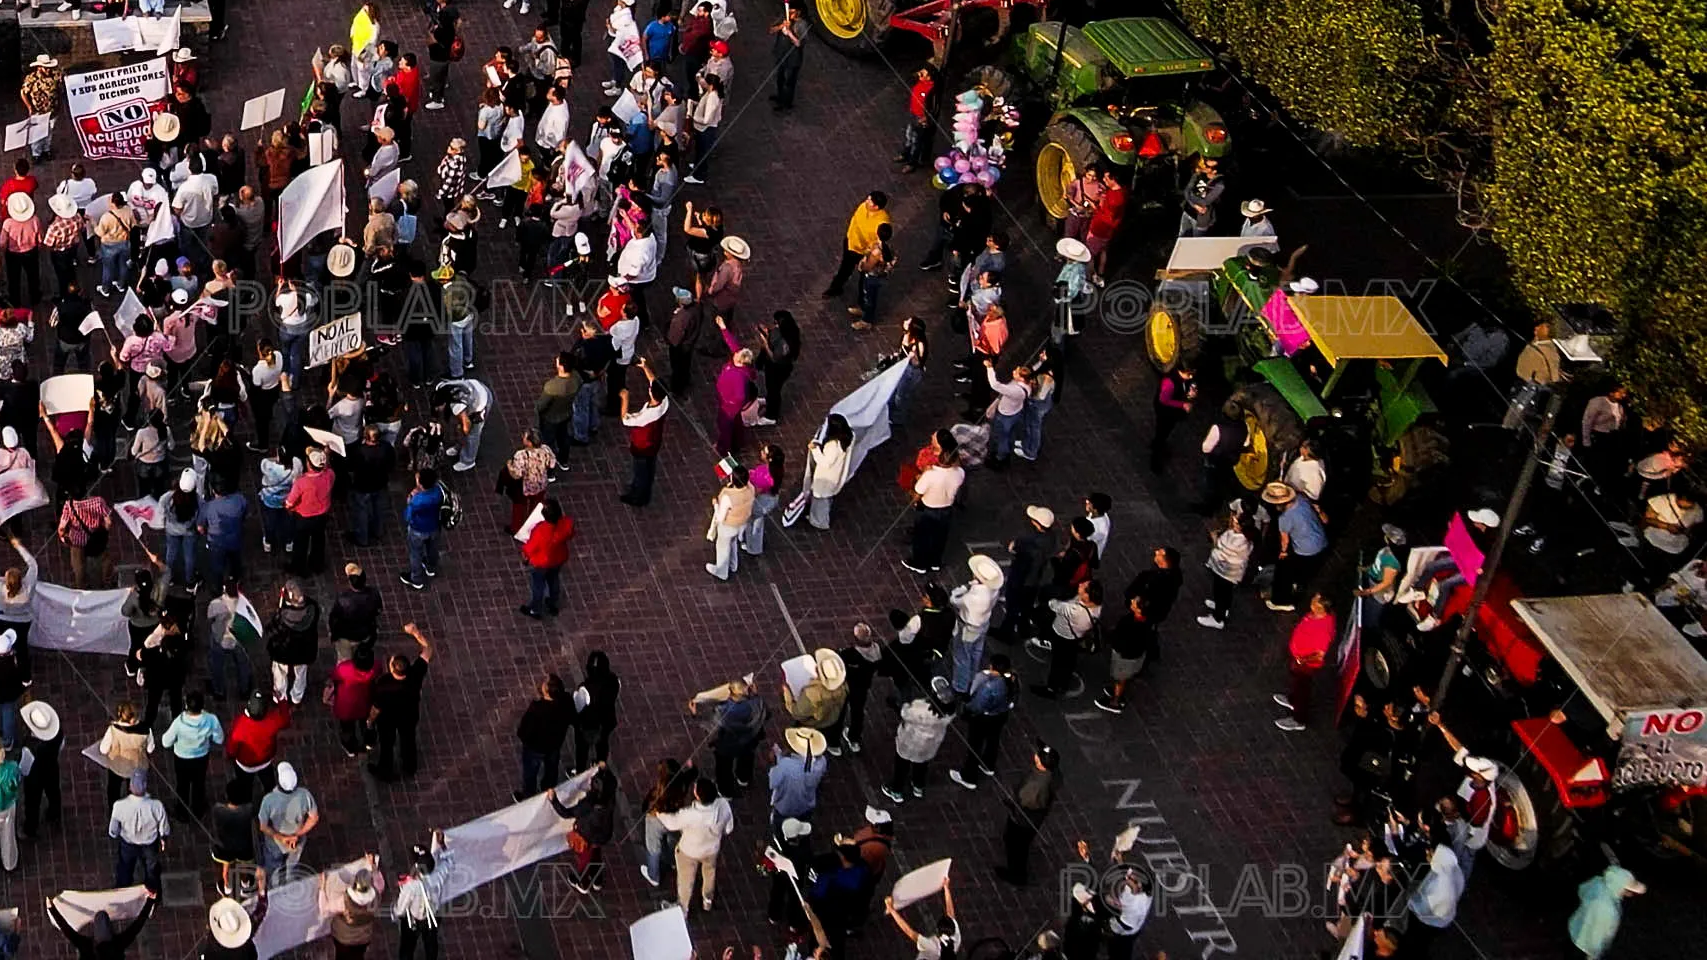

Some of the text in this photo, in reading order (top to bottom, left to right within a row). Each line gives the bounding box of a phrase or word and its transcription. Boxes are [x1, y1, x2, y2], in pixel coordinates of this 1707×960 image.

[79, 84, 97, 95] SUS
[98, 70, 166, 91] AGRICULTORES
[84, 63, 149, 83] MONTE PRIETO
[99, 85, 141, 101] DECIMOS
[104, 103, 144, 127] NO
[87, 124, 153, 143] ACUEDUC
[116, 137, 141, 148] DE LA
[317, 318, 355, 344] NO AL
[1640, 709, 1705, 737] NO
